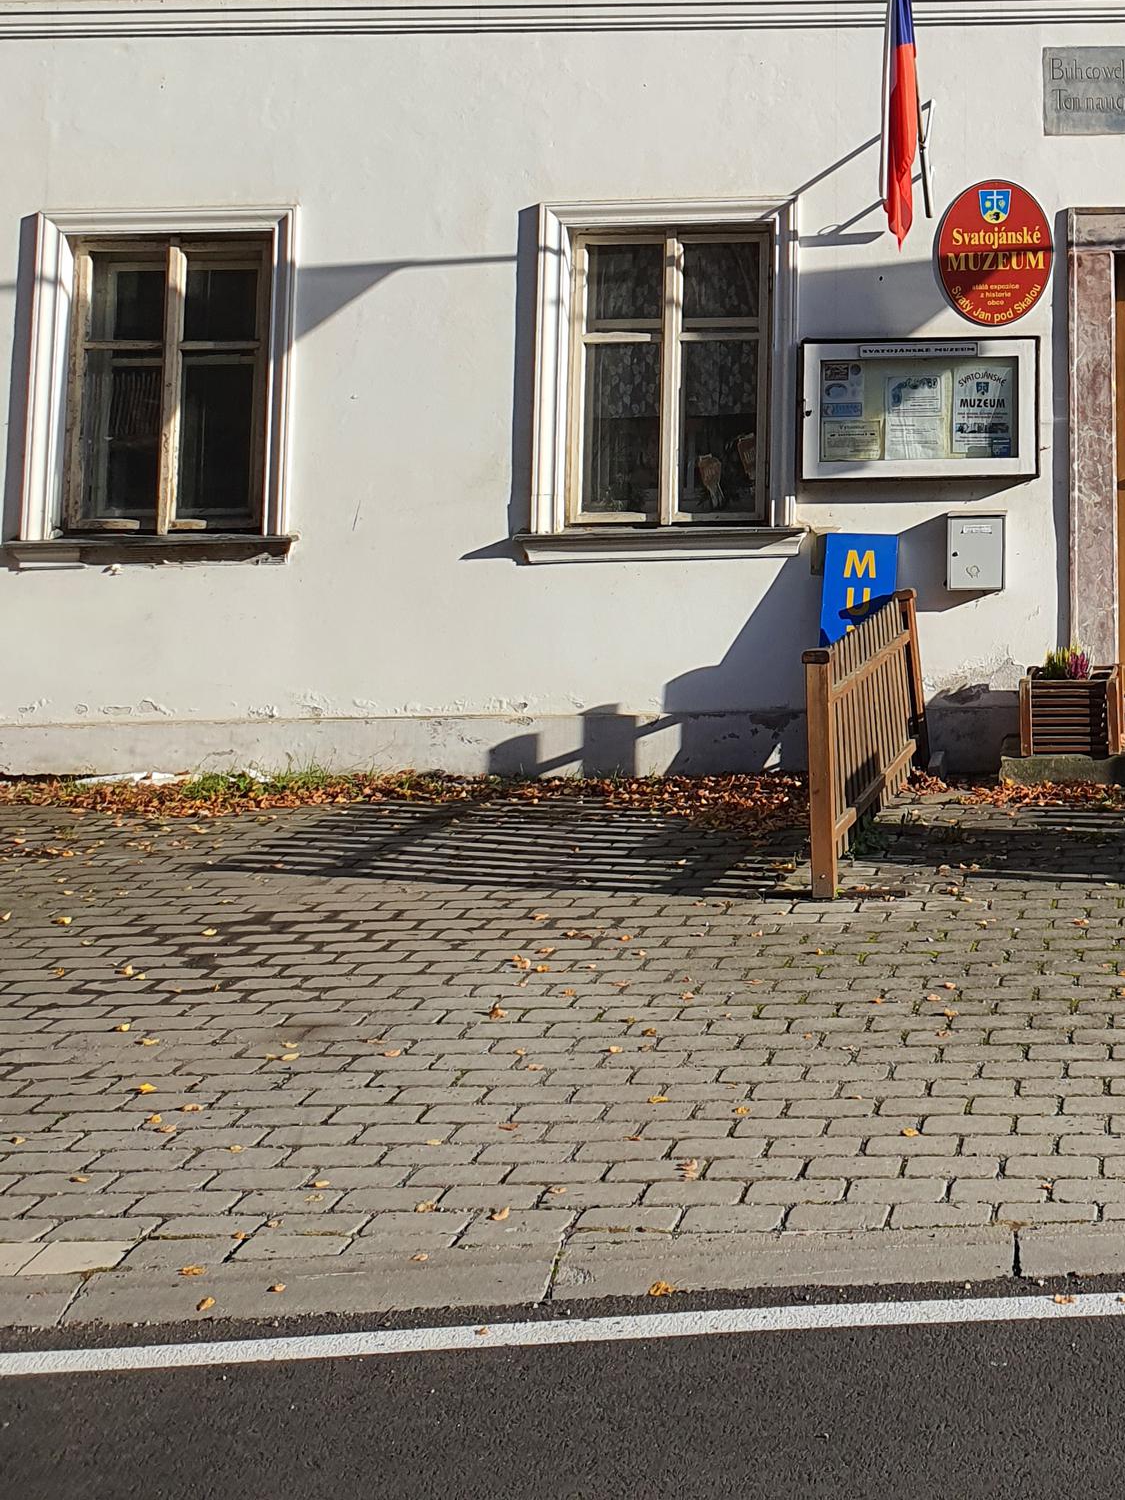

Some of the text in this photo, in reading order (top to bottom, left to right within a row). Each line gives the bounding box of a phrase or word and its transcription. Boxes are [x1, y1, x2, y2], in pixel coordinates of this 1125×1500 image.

[952, 226, 1041, 249] Svatojánské
[946, 250, 1046, 272] MUZEUM
[952, 284, 1042, 325] Svatý Jan pod Skalou
[960, 398, 1006, 409] MUZEUM
